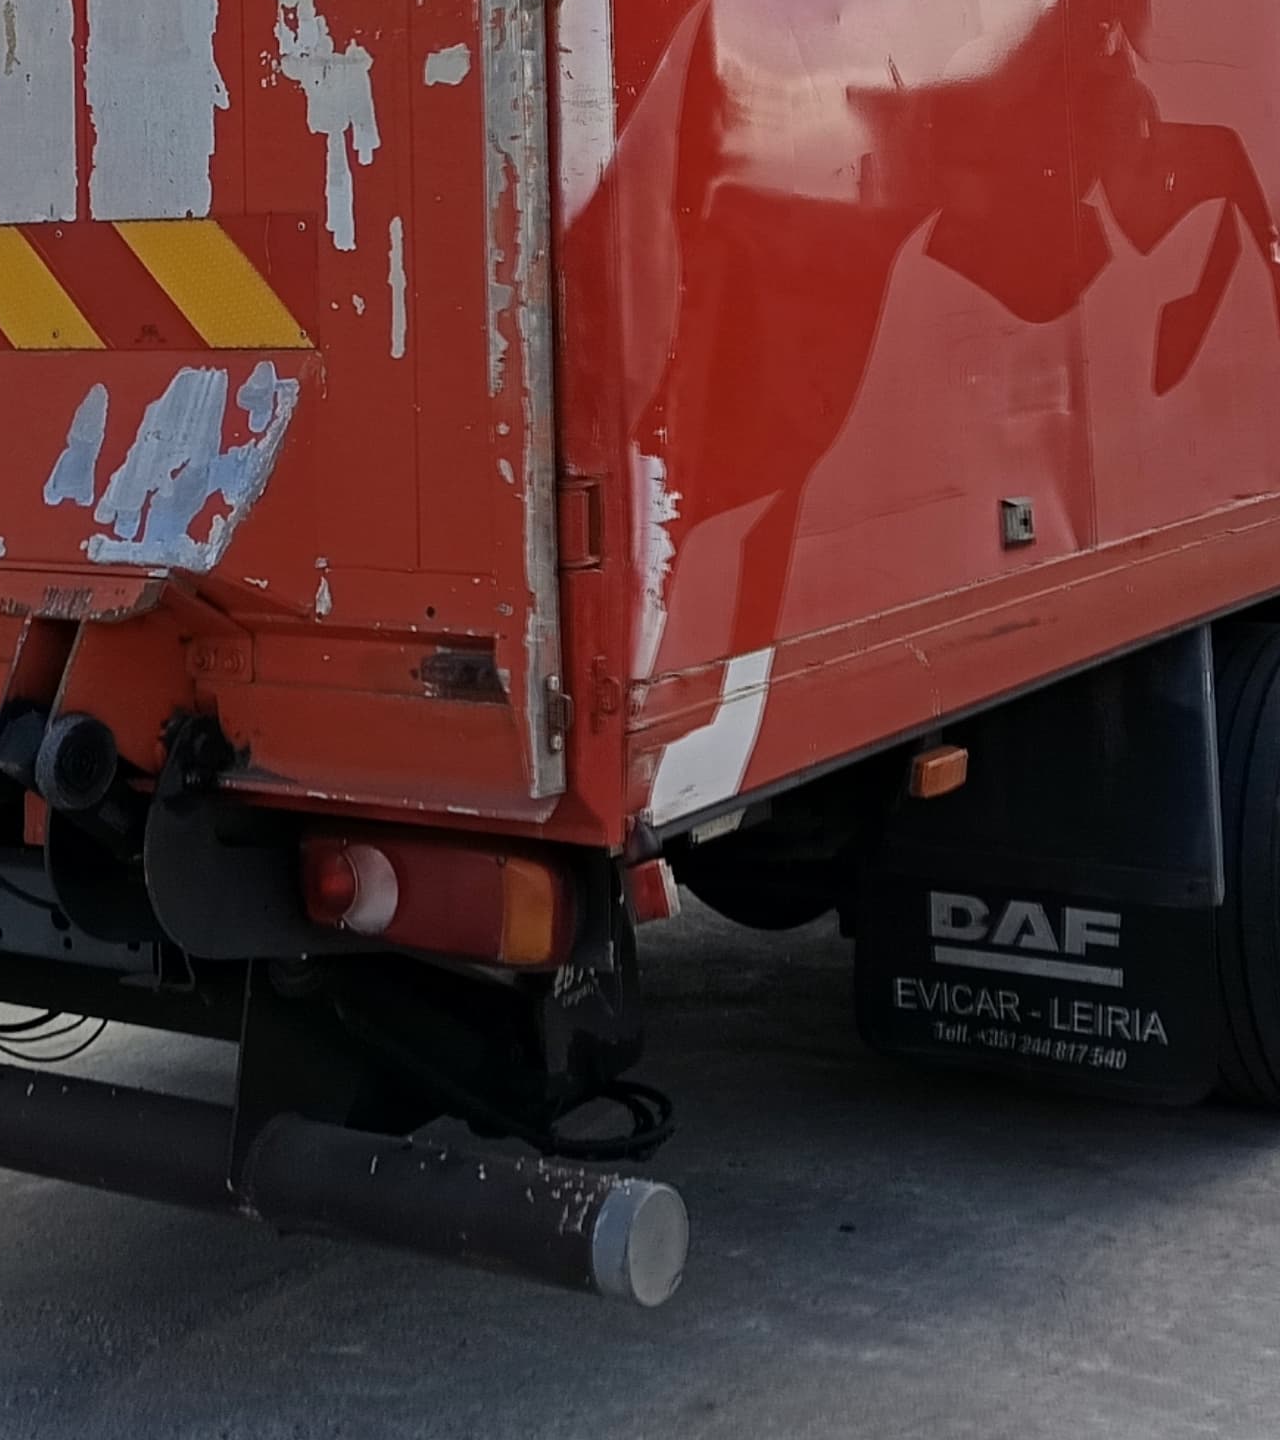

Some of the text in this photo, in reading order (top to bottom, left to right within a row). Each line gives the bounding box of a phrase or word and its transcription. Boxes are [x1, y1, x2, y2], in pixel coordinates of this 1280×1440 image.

[930, 890, 1121, 957] DAF
[893, 976, 1021, 1023] EVICAR
[1049, 996, 1169, 1046] LEIRIA
